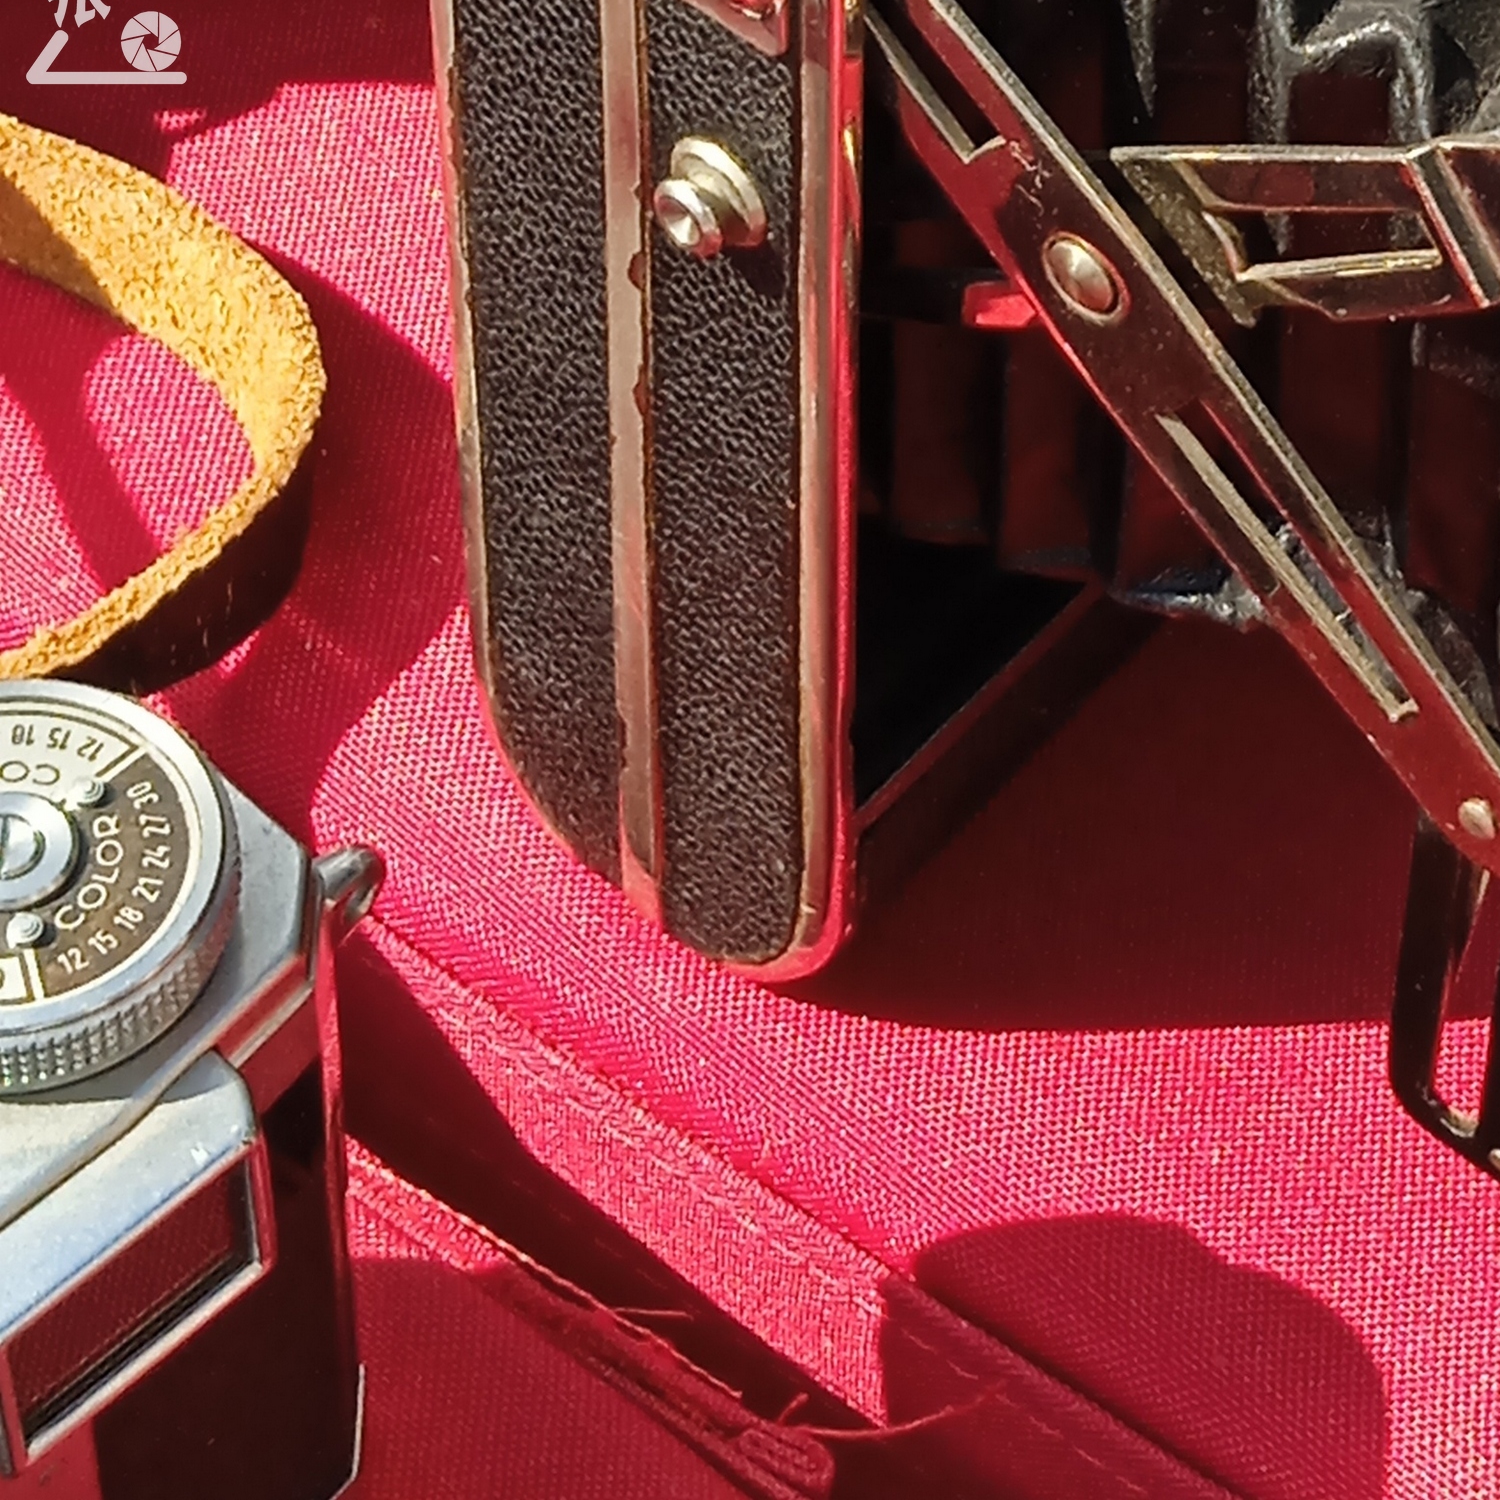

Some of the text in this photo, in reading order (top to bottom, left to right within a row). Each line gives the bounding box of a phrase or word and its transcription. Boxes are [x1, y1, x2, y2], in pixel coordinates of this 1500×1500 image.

[46, 726, 72, 751] 15
[76, 735, 105, 763] 12
[53, 813, 125, 931] COLOR
[56, 780, 173, 975] 12 15 18 21 24 27 30
